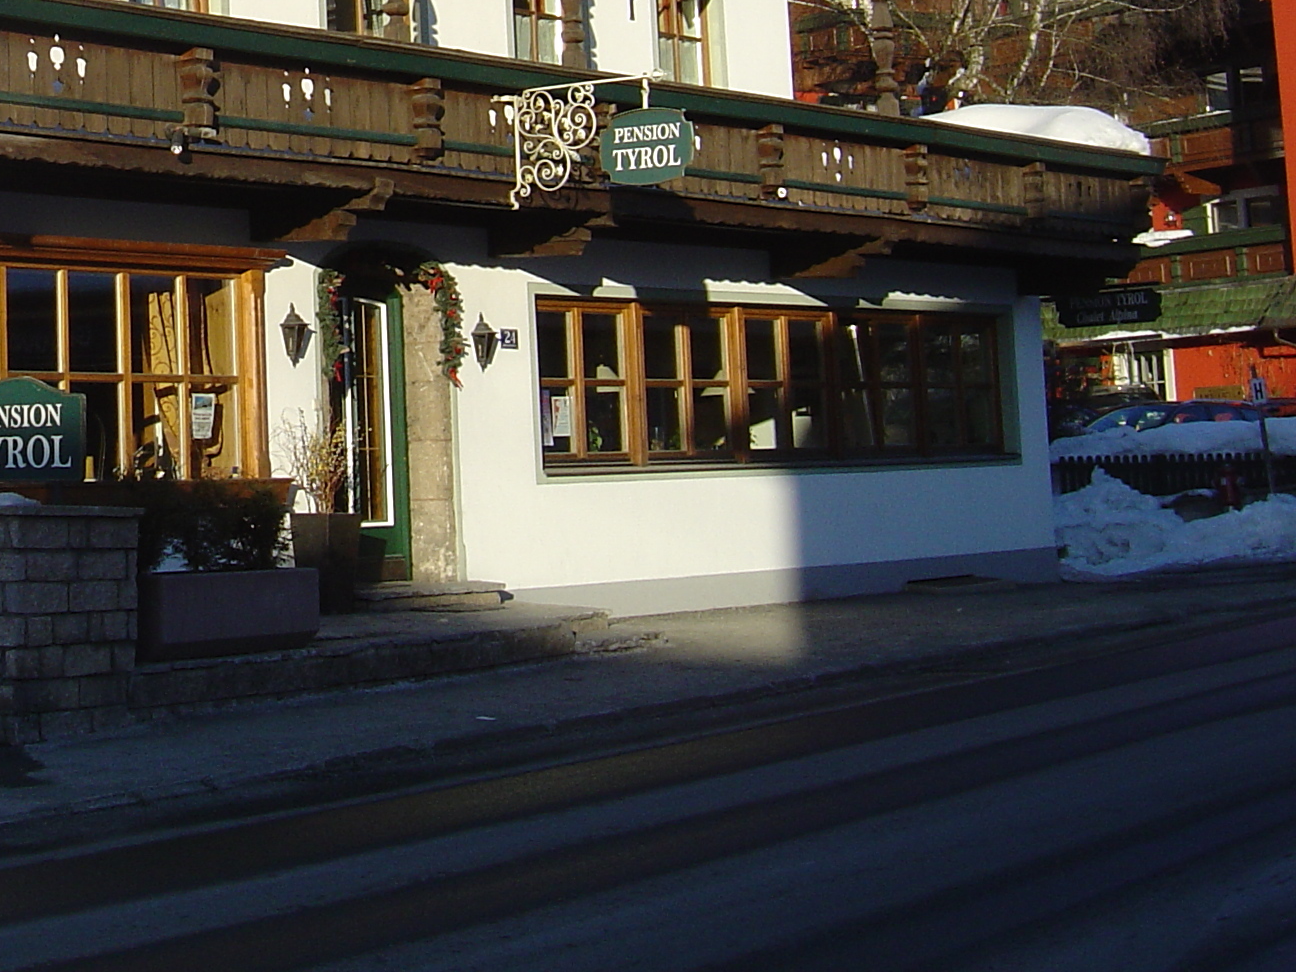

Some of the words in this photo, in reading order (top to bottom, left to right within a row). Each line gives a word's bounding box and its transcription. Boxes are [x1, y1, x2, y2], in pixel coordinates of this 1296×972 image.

[614, 122, 681, 144] PENSION
[612, 144, 681, 172] TYROL
[1116, 291, 1148, 306] TYROL
[503, 330, 516, 344] 24
[1253, 382, 1264, 401] H
